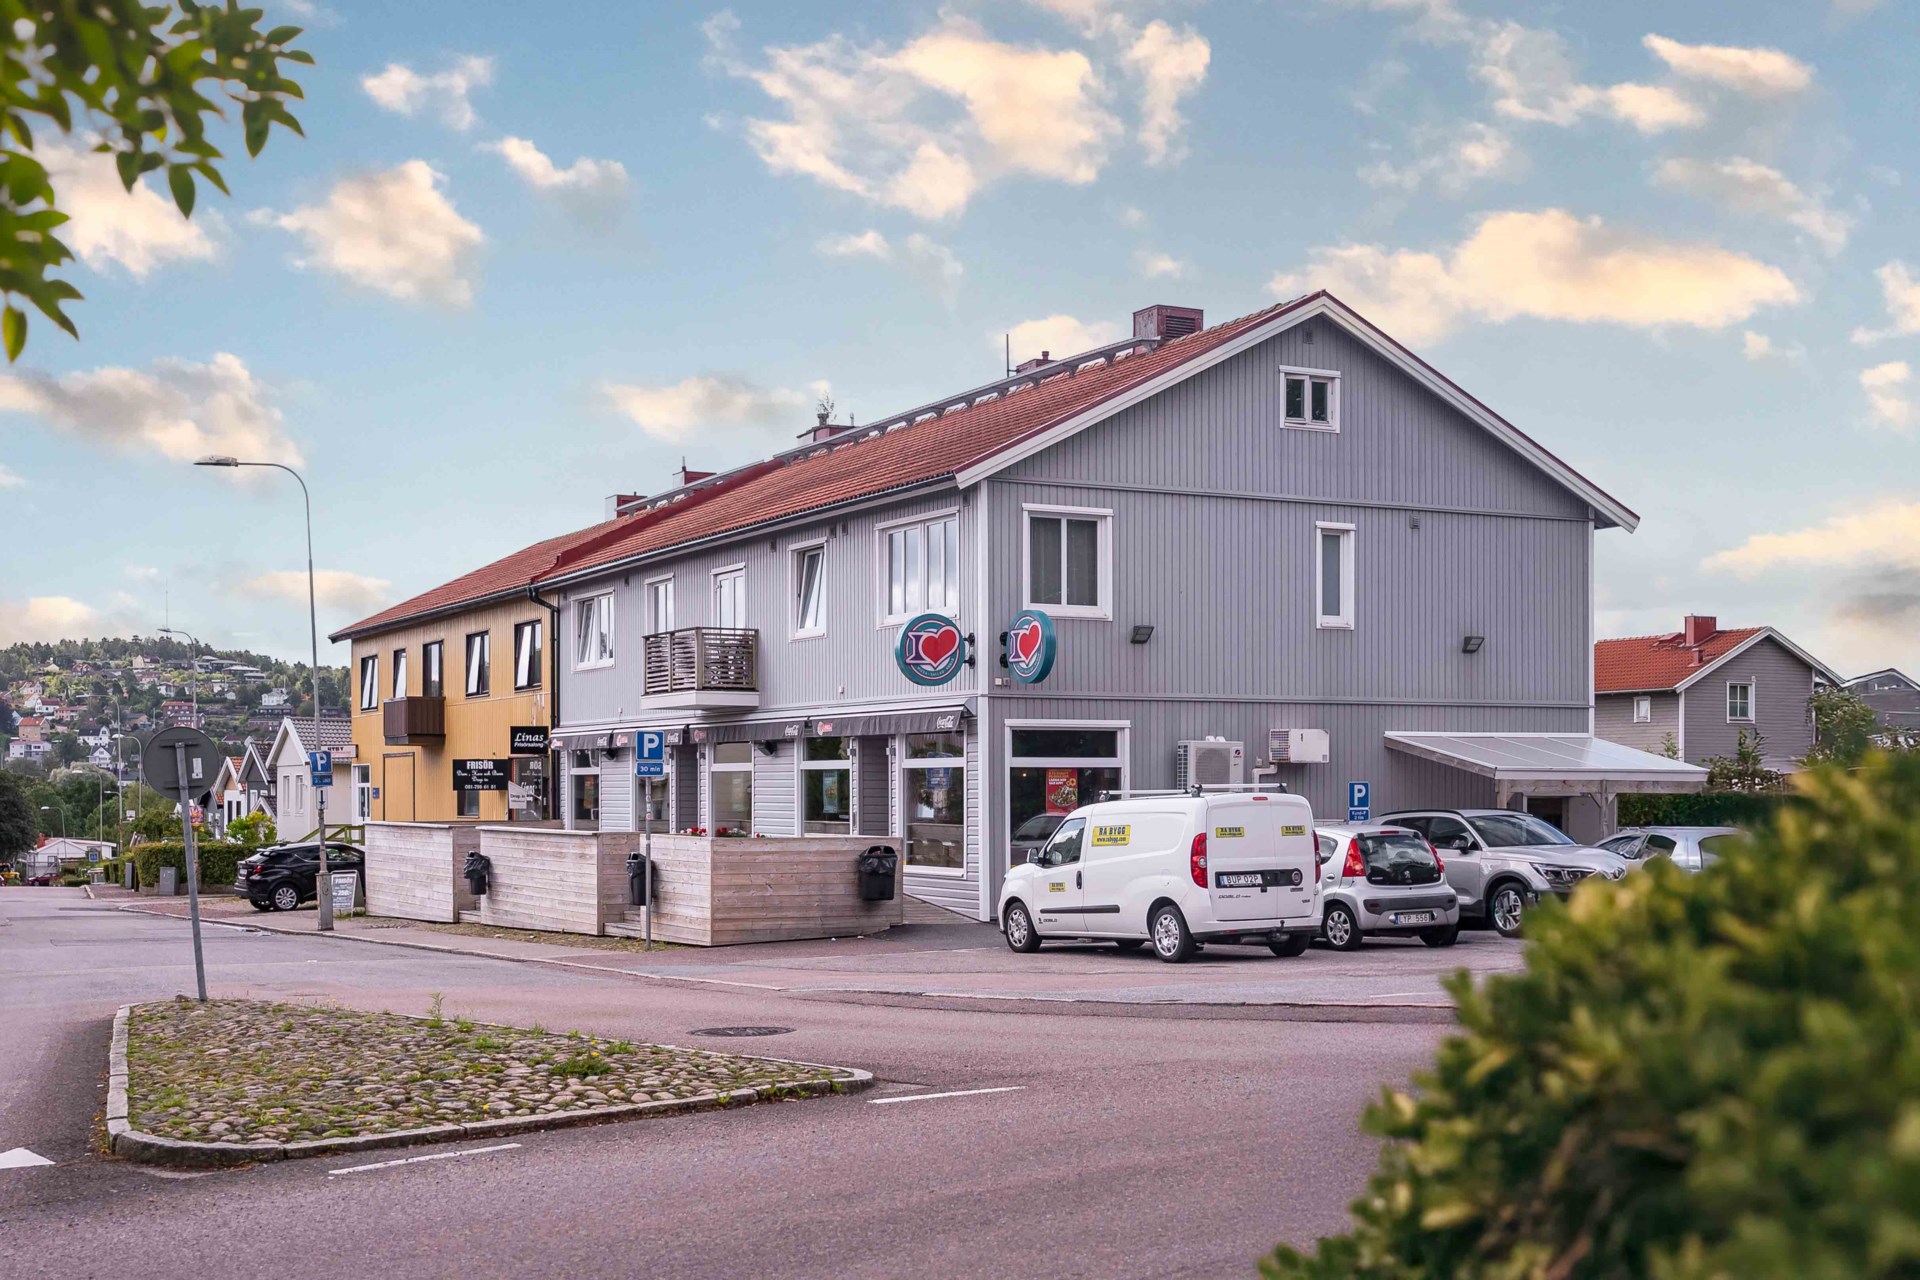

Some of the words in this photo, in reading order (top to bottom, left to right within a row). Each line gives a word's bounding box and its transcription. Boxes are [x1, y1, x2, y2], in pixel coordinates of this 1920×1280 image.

[514, 732, 544, 742] Linas
[643, 733, 659, 758] P
[316, 753, 327, 771] P
[466, 760, 494, 770] FRISÖR
[1354, 784, 1366, 806] P
[1109, 826, 1126, 835] BYGG
[1226, 875, 1242, 884] BUP
